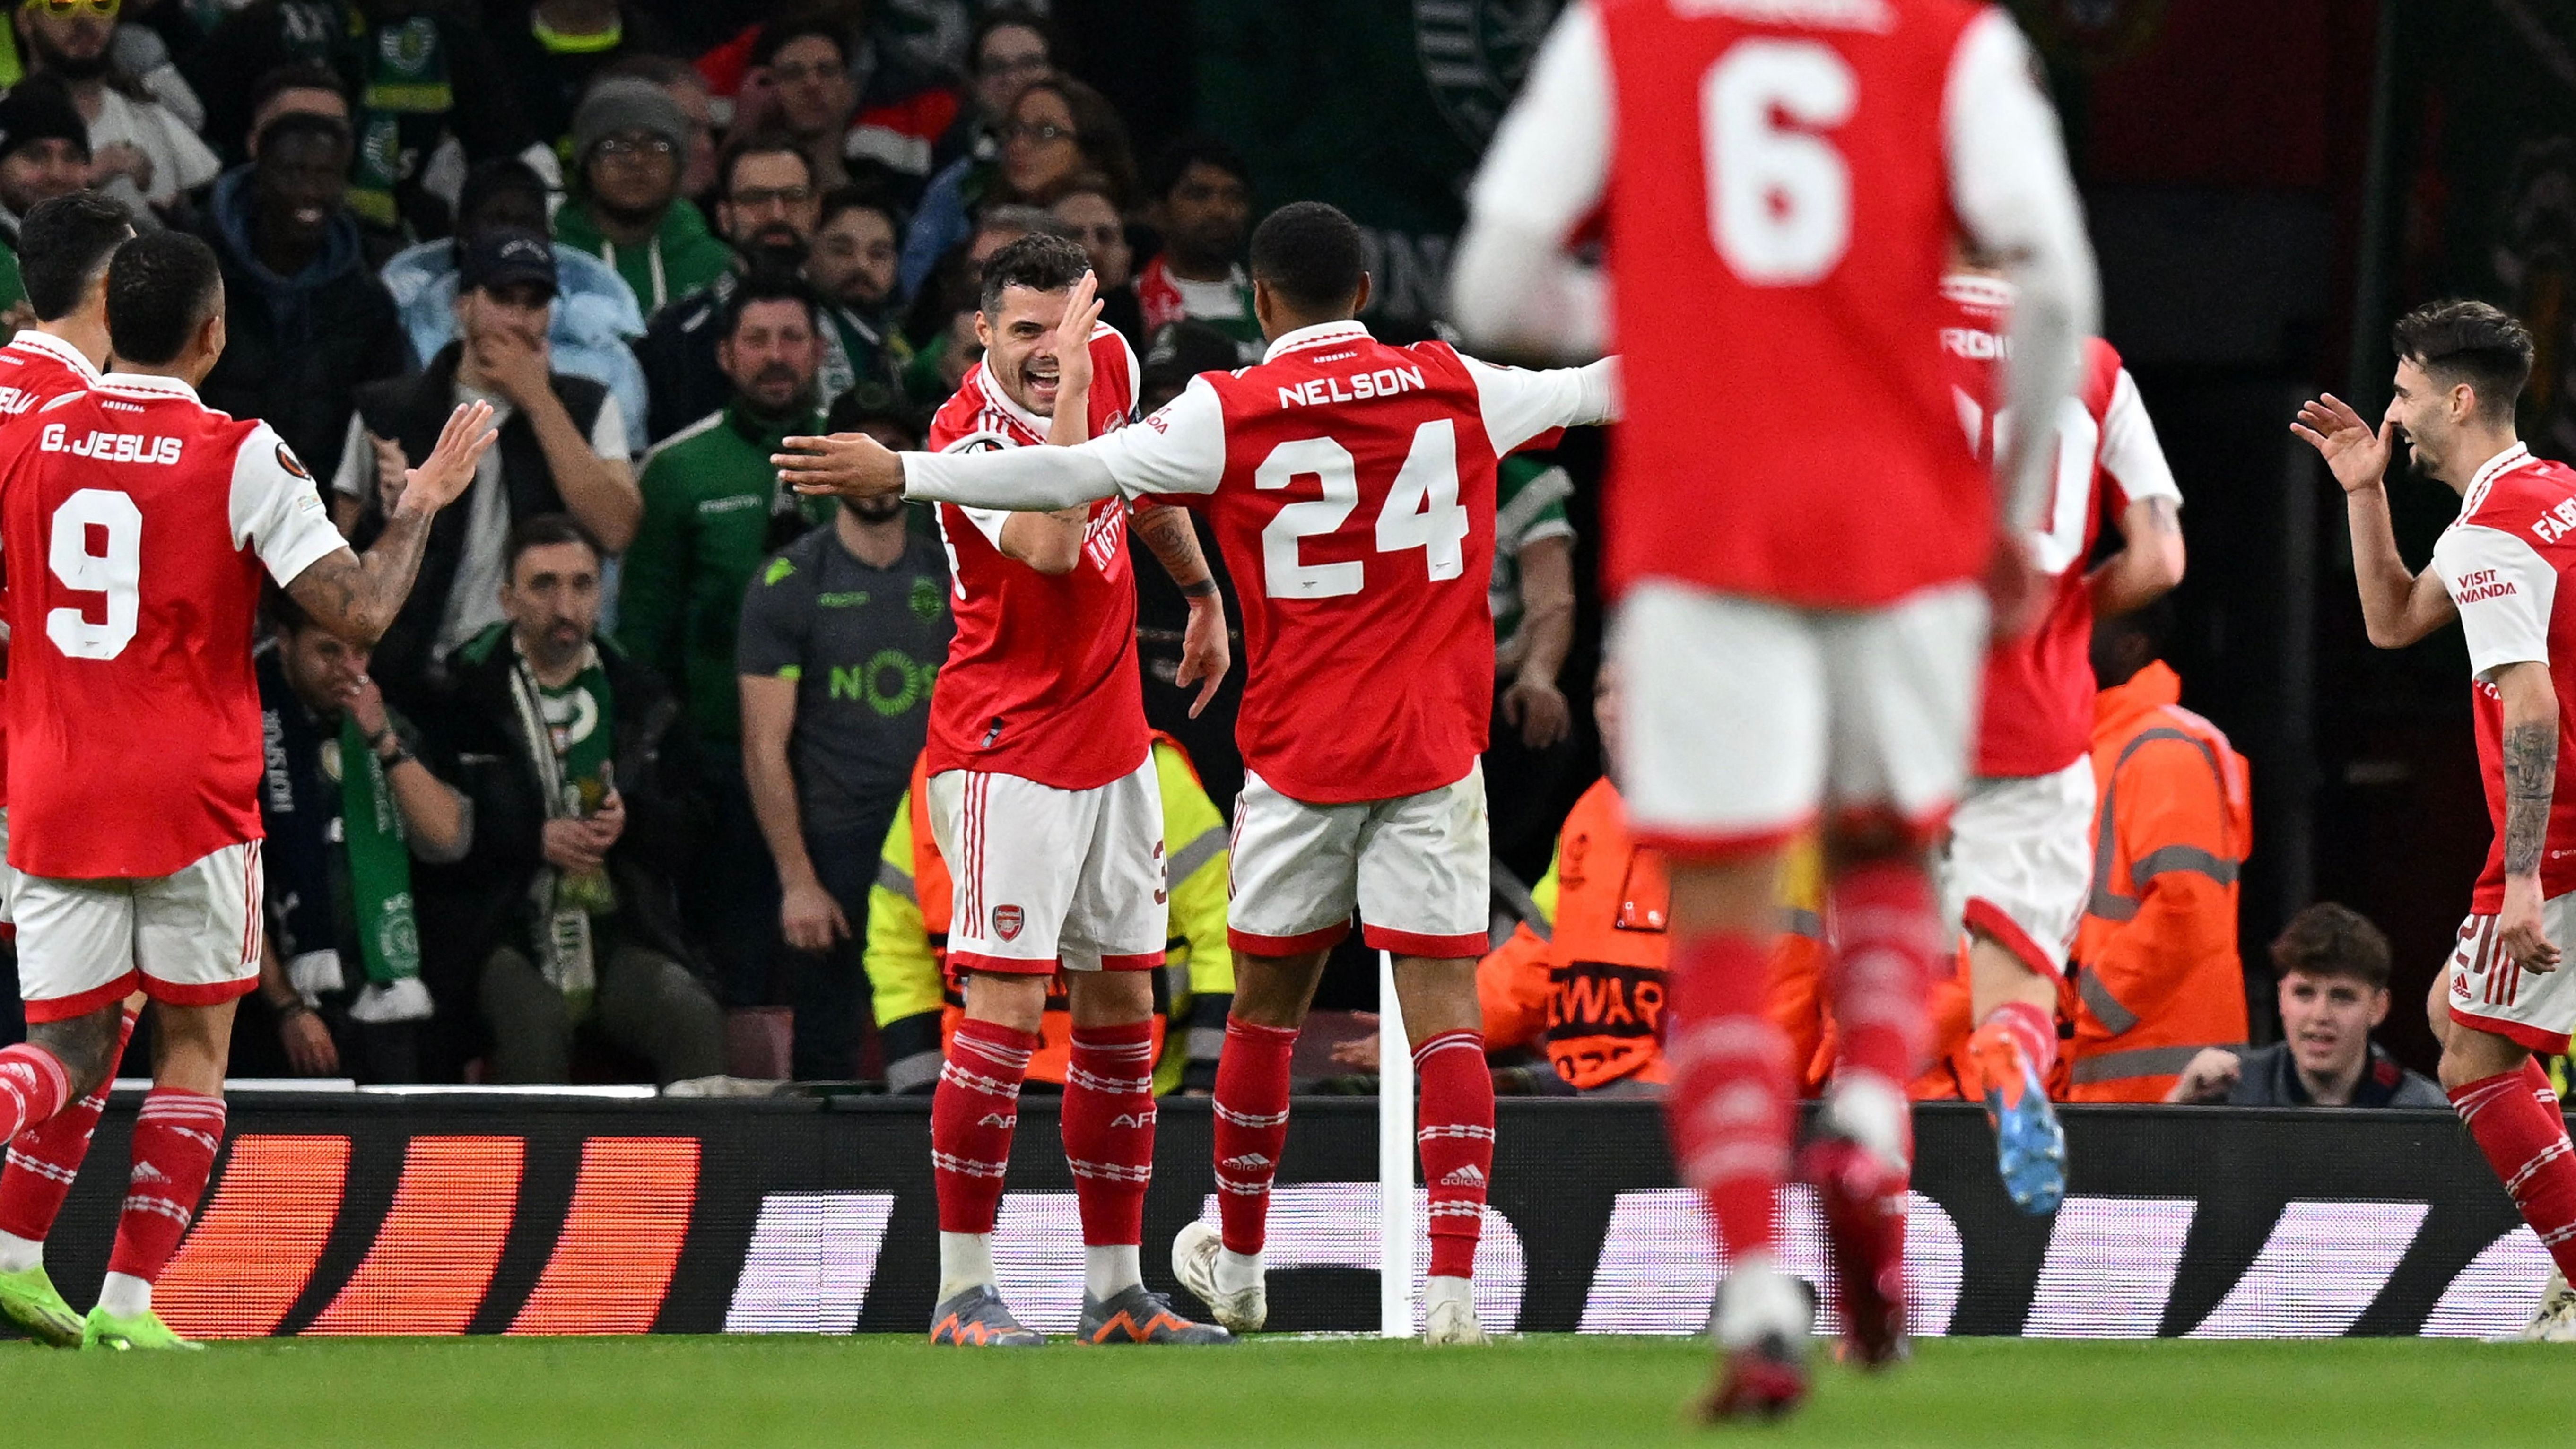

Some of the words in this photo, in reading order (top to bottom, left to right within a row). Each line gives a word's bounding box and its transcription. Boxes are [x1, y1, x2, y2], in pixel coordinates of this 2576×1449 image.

[1699, 36, 1860, 287] 6
[1940, 327, 2013, 358] RGI
[1278, 365, 1426, 409] NELSON
[40, 423, 183, 465] G.JESUS
[1254, 418, 1469, 599] 24
[46, 488, 143, 660] 9
[2456, 582, 2517, 605] WANDA
[2457, 569, 2496, 588] VISIT
[1440, 1173, 1486, 1190] adidas
